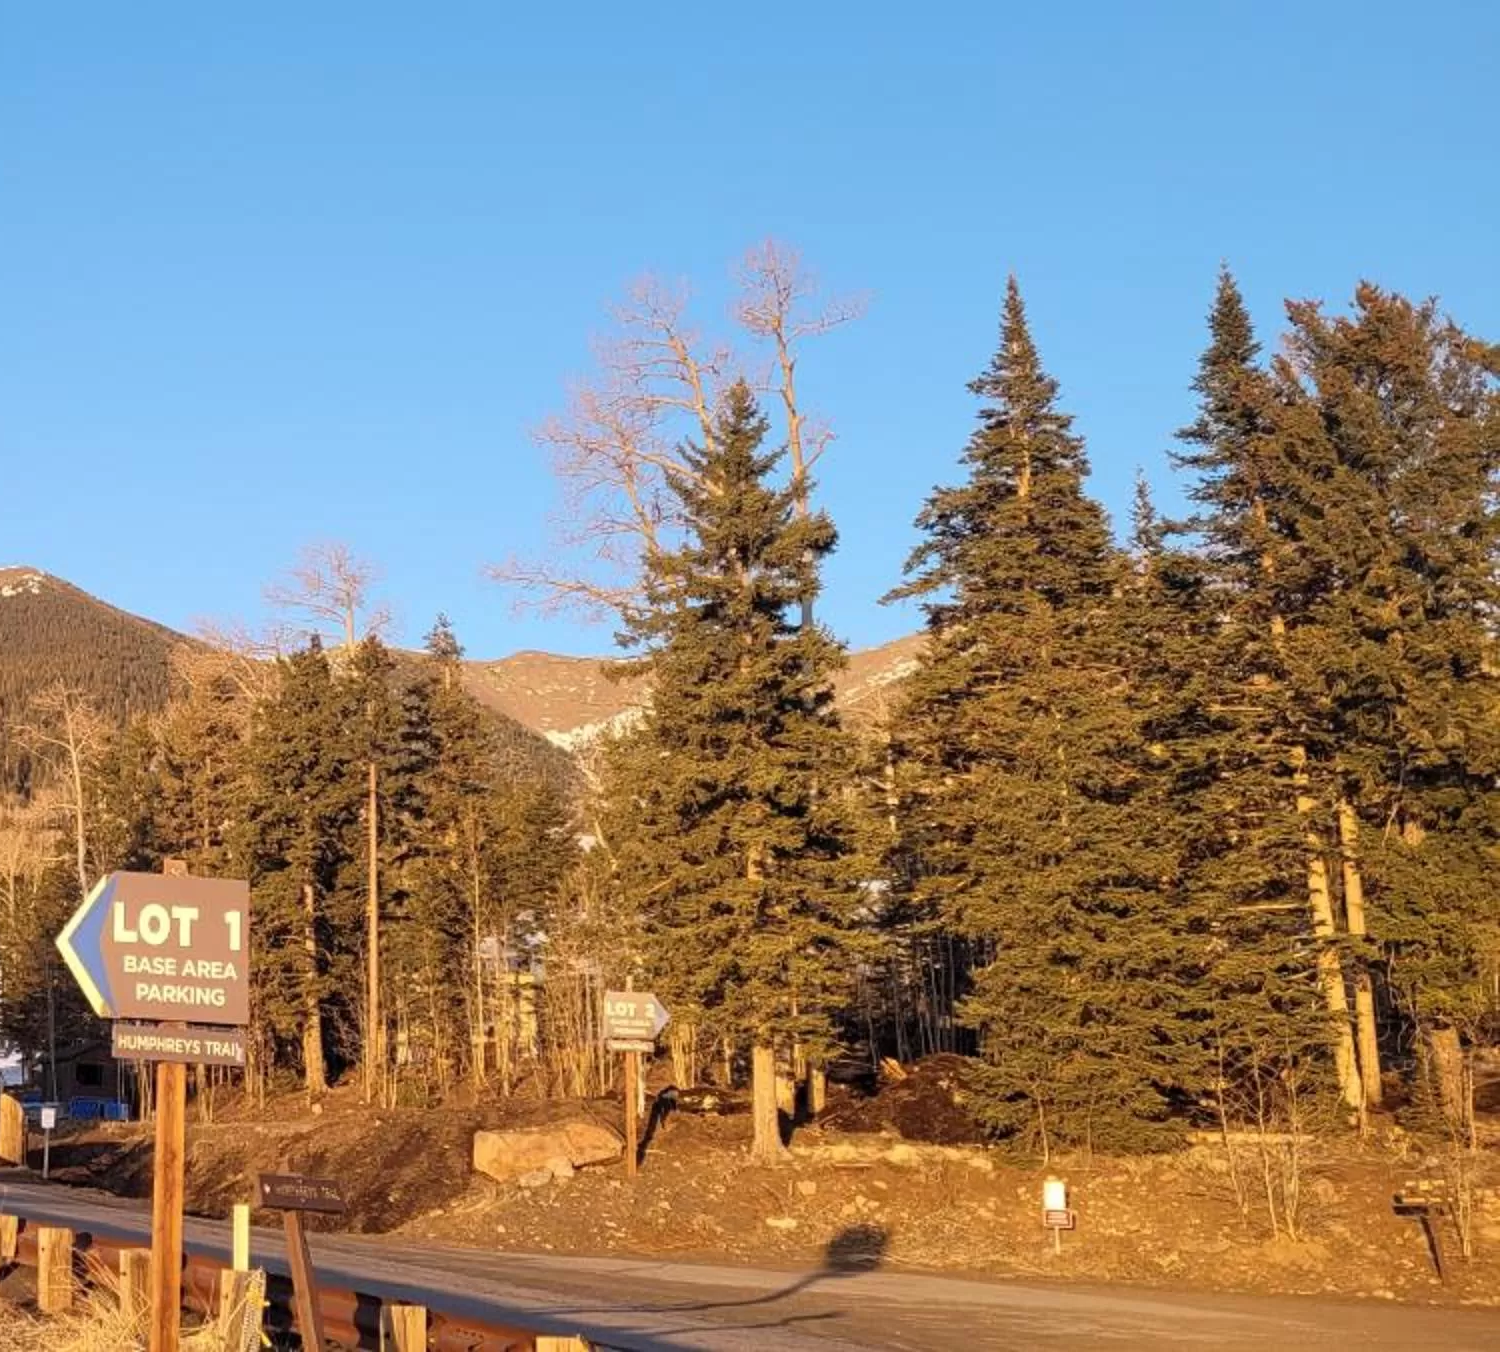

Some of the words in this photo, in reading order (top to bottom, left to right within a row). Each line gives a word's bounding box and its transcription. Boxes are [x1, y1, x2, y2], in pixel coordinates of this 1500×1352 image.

[113, 901, 199, 947] LOT
[224, 910, 241, 951] 1
[123, 954, 177, 976] BASE
[181, 959, 238, 980] AREA
[135, 982, 226, 1006] PARKING
[607, 1001, 637, 1017] LOT
[117, 1034, 202, 1055] HUMPHREYS
